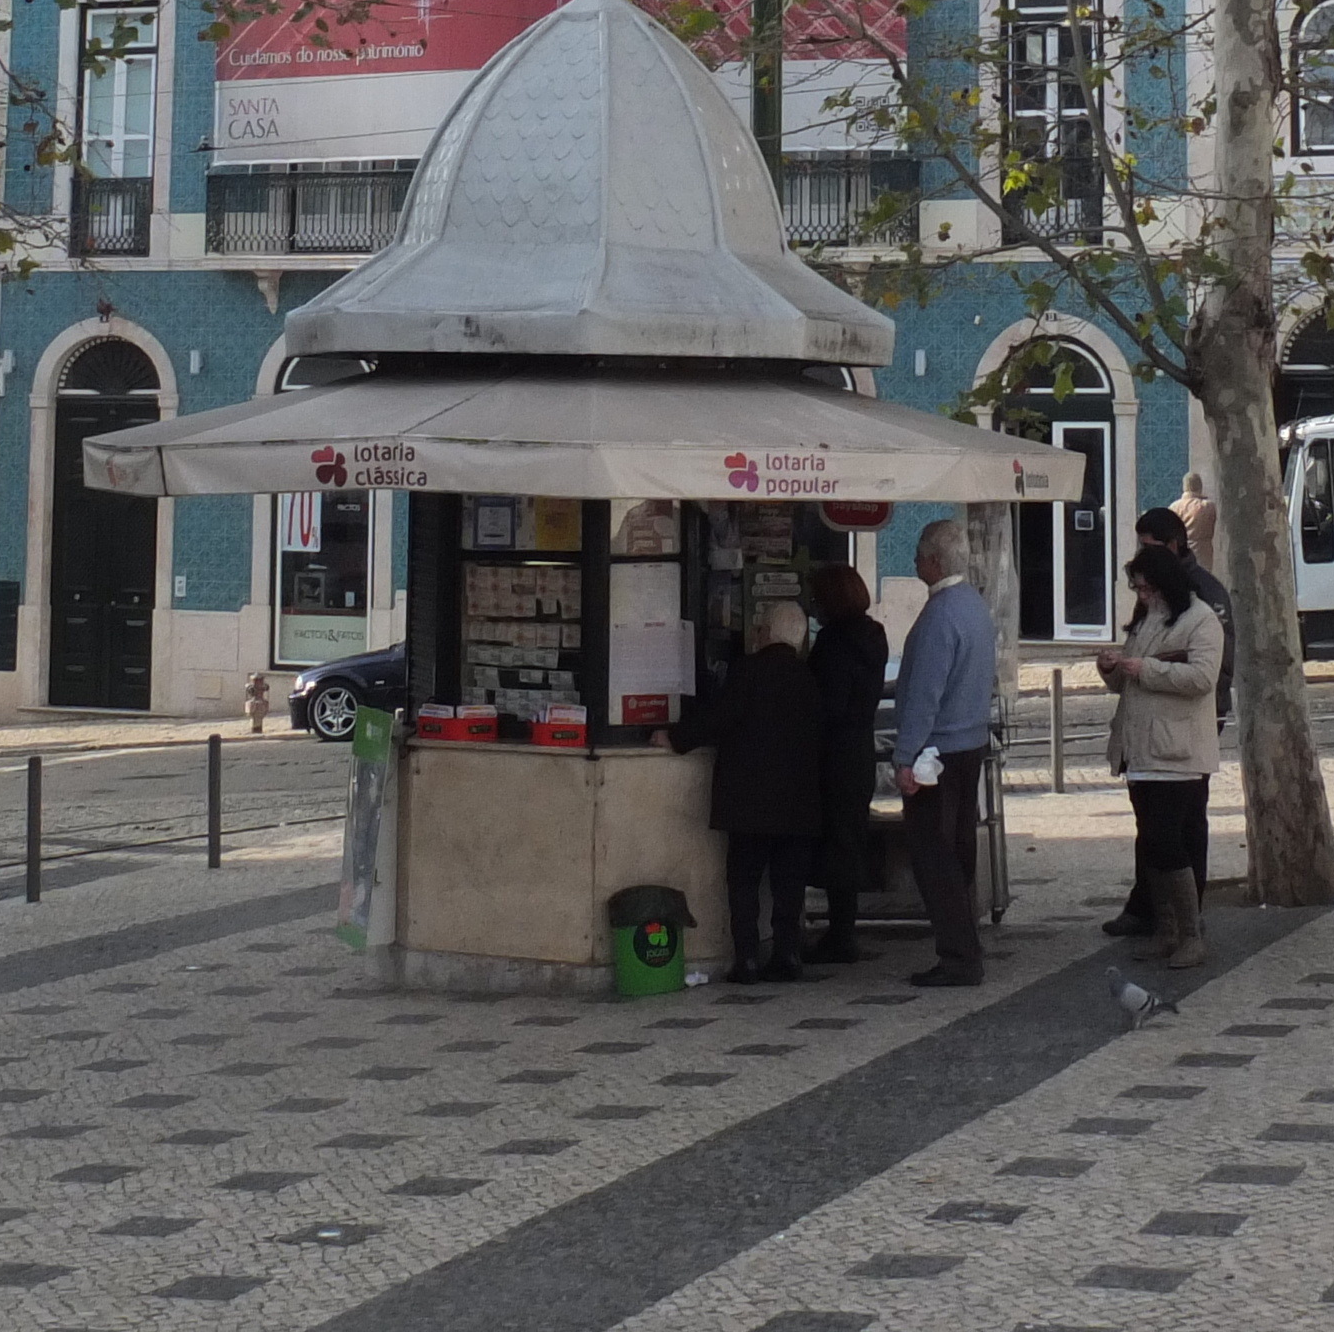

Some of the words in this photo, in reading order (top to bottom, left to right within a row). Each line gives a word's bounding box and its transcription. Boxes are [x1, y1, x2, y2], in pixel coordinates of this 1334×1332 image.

[229, 47, 292, 66] Cuidamos
[296, 45, 313, 63] do
[229, 97, 280, 117] SANTA
[228, 118, 280, 140] CASA
[355, 442, 416, 463] lotaria
[766, 453, 826, 472] lotaria
[355, 466, 428, 487] clássica
[766, 476, 840, 497] popular
